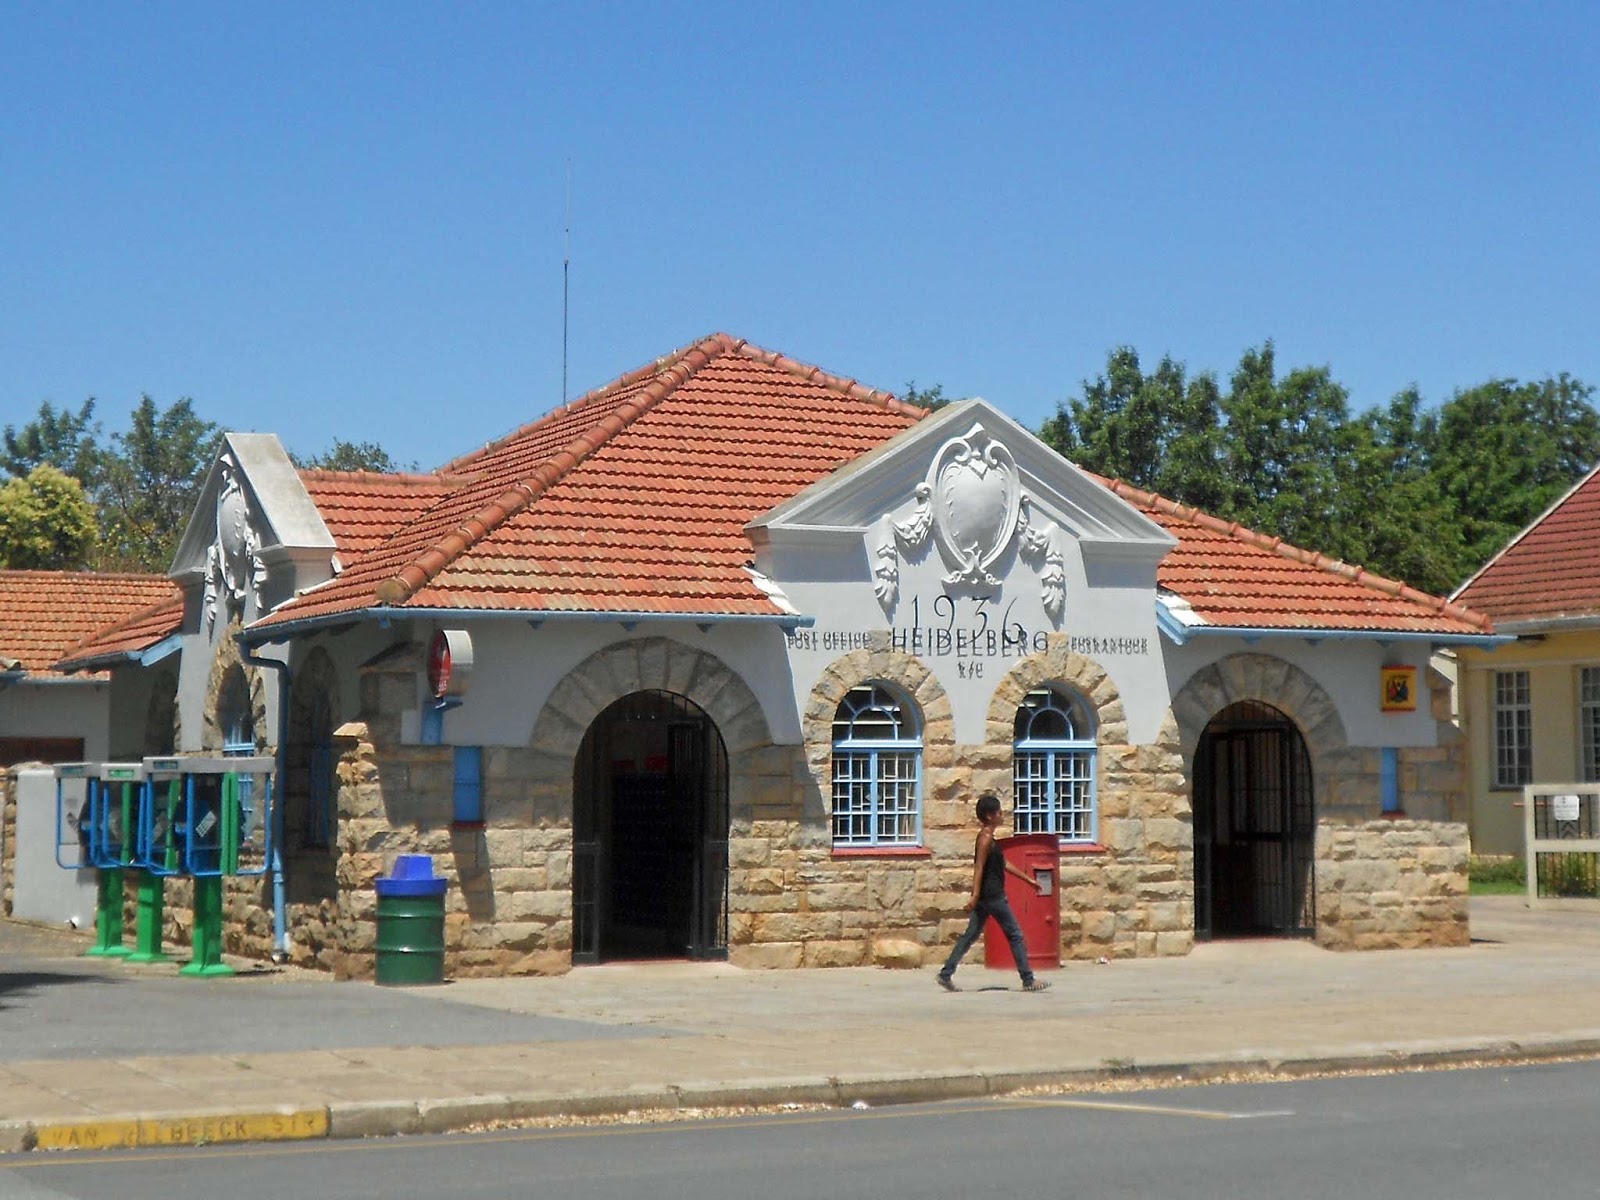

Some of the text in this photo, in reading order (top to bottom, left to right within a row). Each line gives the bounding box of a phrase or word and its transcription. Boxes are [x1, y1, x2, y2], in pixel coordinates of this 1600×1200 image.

[911, 594, 1028, 646] 1936
[787, 631, 871, 652] POST OFFICE
[892, 627, 1048, 658] HEIDELBERG
